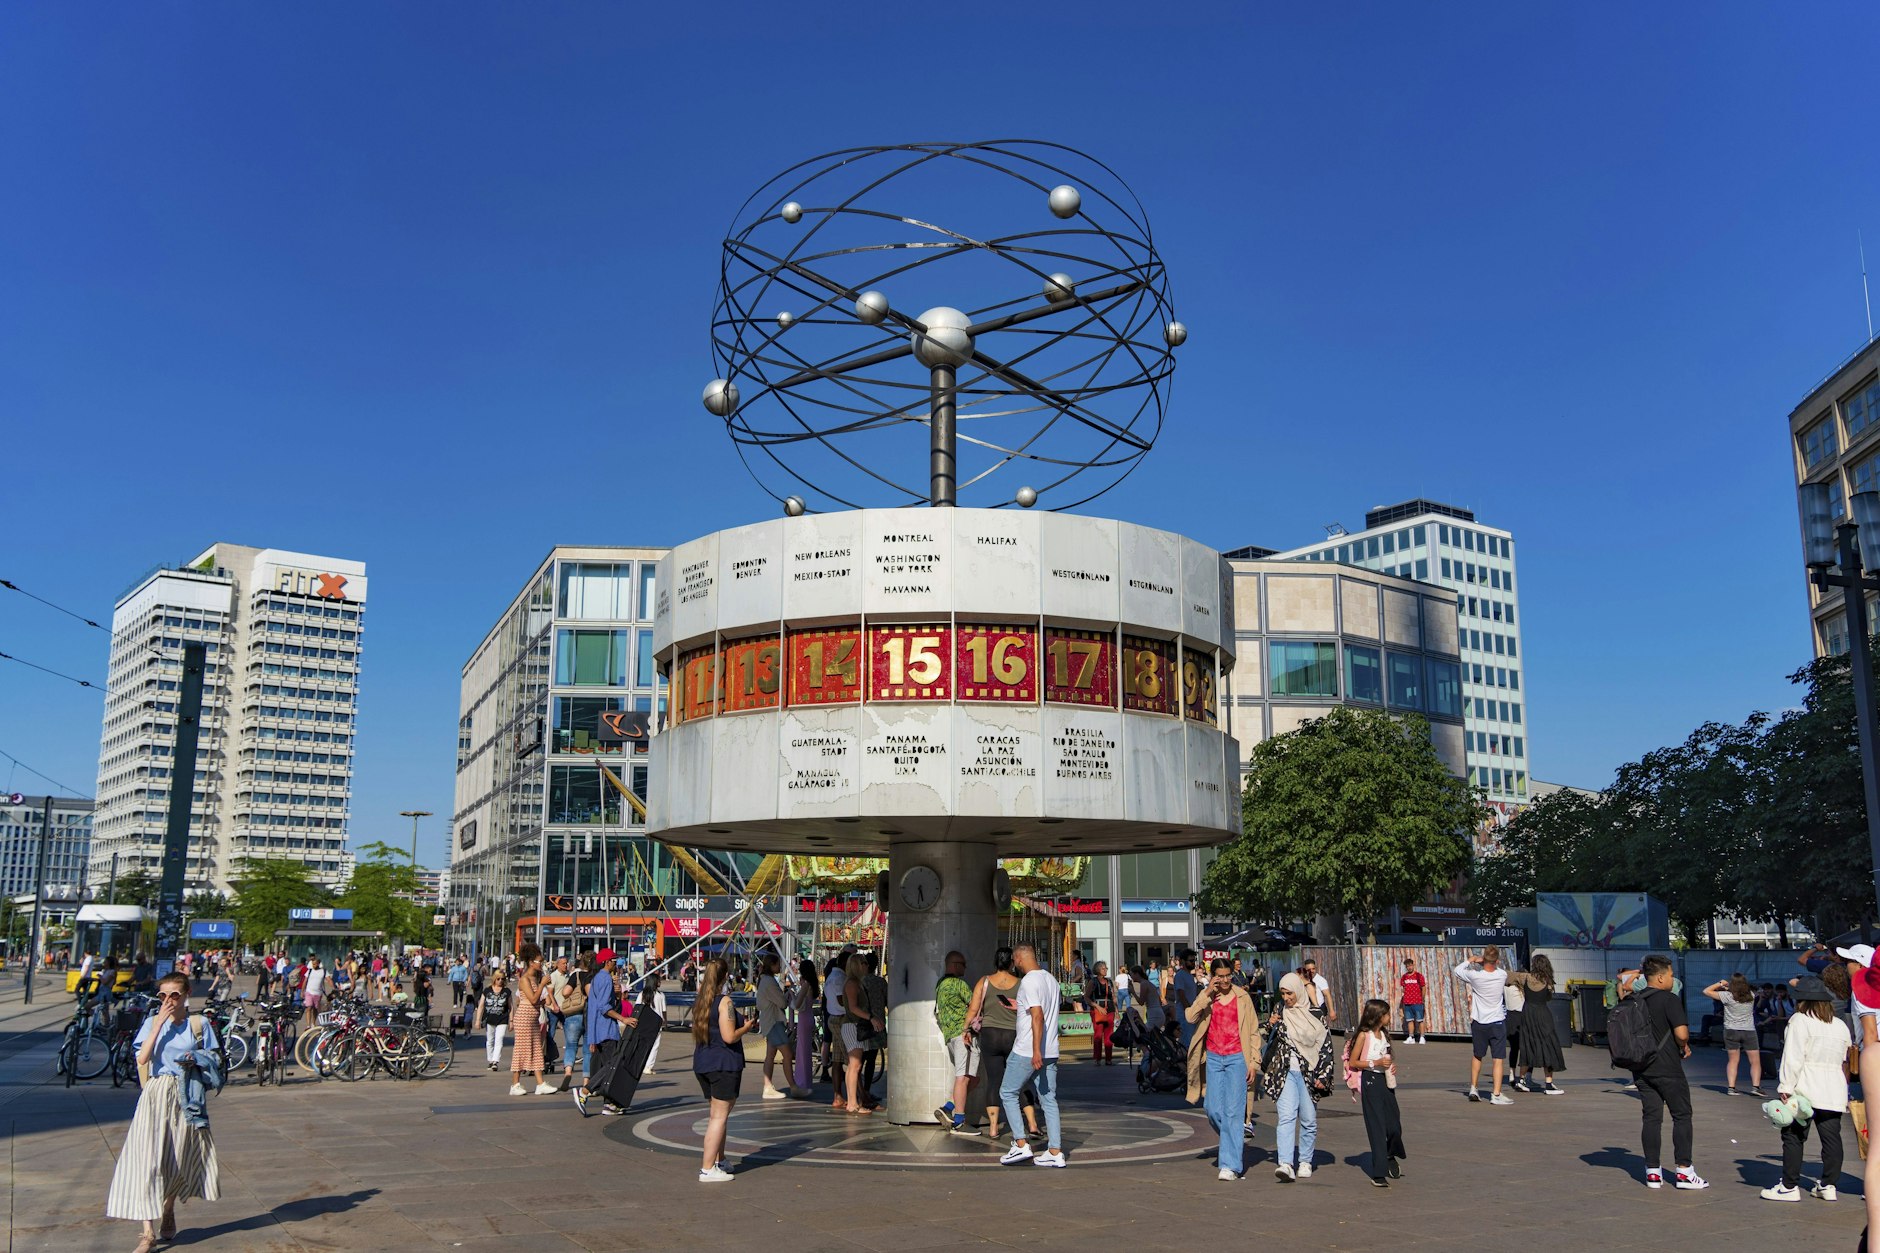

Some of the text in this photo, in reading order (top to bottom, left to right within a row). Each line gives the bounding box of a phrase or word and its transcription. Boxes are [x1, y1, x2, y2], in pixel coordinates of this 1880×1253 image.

[883, 534, 933, 543] MONTREAL
[977, 536, 1017, 545] HALIFAX
[795, 548, 851, 561] NEW ORLEANS
[875, 554, 941, 563] WASHINGTON
[682, 560, 709, 575] VANCOUVER
[732, 557, 767, 570] EDMONTON
[883, 565, 933, 573] NEW YORK
[685, 570, 705, 583] DAWSON
[736, 568, 762, 580] DENVER
[794, 568, 851, 581] MEXIKO-STADT
[1051, 568, 1110, 582] WESTGRÖNLAND
[678, 586, 686, 596] SAN
[687, 577, 713, 593] FRANCISCO
[884, 585, 931, 594] HAVANNA
[1129, 579, 1173, 595] OSTGRÖNLAND
[689, 589, 708, 601] ANGELES
[803, 639, 856, 688] 14
[882, 636, 942, 685] 15
[966, 636, 1026, 685] 16
[1048, 640, 1102, 689] 17
[740, 645, 780, 695] 13
[1123, 648, 1161, 698] 18
[695, 655, 725, 705] 12
[1065, 728, 1104, 738] BRASILIA
[792, 737, 847, 747] GUATEMALA-
[886, 735, 927, 744] PANAMA
[977, 736, 1020, 745] CARACAS
[1053, 737, 1115, 749] RIO DE JANEIRO
[821, 747, 847, 756] STADT
[998, 747, 1015, 755] PAZ
[1063, 747, 1105, 758] SÃO PAULO
[894, 756, 919, 764] QUITO
[975, 756, 1022, 765] ASUNCIÓN
[1060, 759, 1109, 769] MONTEVIDEO
[797, 769, 840, 778] MANAGUA
[895, 767, 917, 775] LIMA
[1056, 769, 1112, 780] BUENOS AIRES
[788, 778, 836, 789] GALÁPAGOS
[577, 896, 628, 911] SATURN
[292, 909, 300, 919] U
[209, 924, 217, 932] U
[678, 928, 697, 936] -70%
[1476, 928, 1497, 937] 0050
[1501, 929, 1524, 937] 21505
[1204, 951, 1229, 959] SALE
